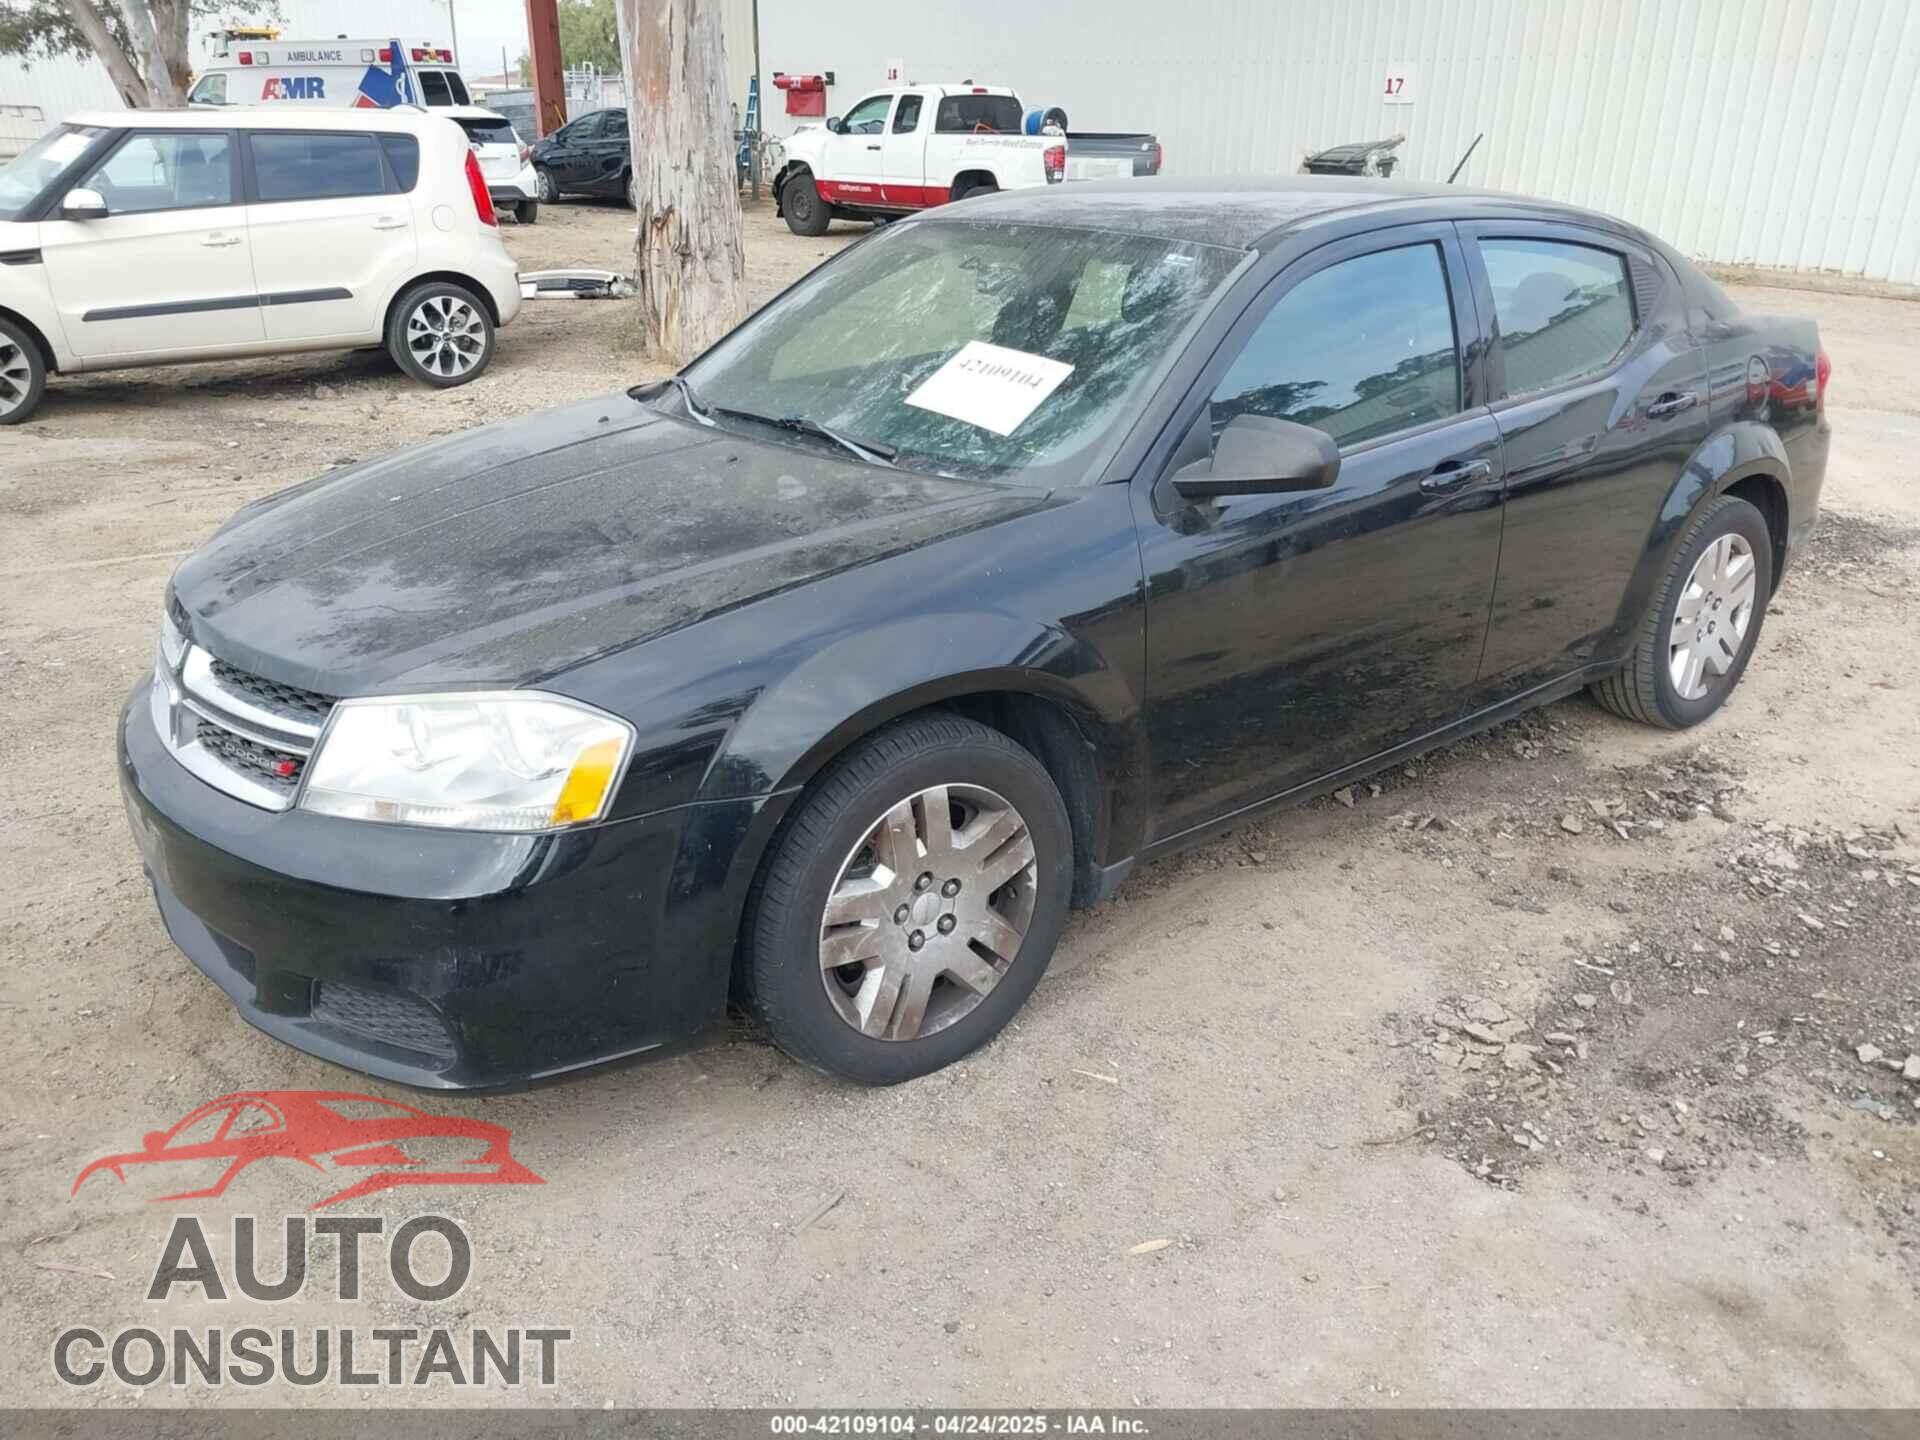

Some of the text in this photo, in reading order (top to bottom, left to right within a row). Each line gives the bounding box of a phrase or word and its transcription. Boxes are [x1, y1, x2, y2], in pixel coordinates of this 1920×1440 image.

[287, 50, 342, 61] AMBULANCE
[262, 77, 325, 100] AMR
[1384, 78, 1404, 94] 17
